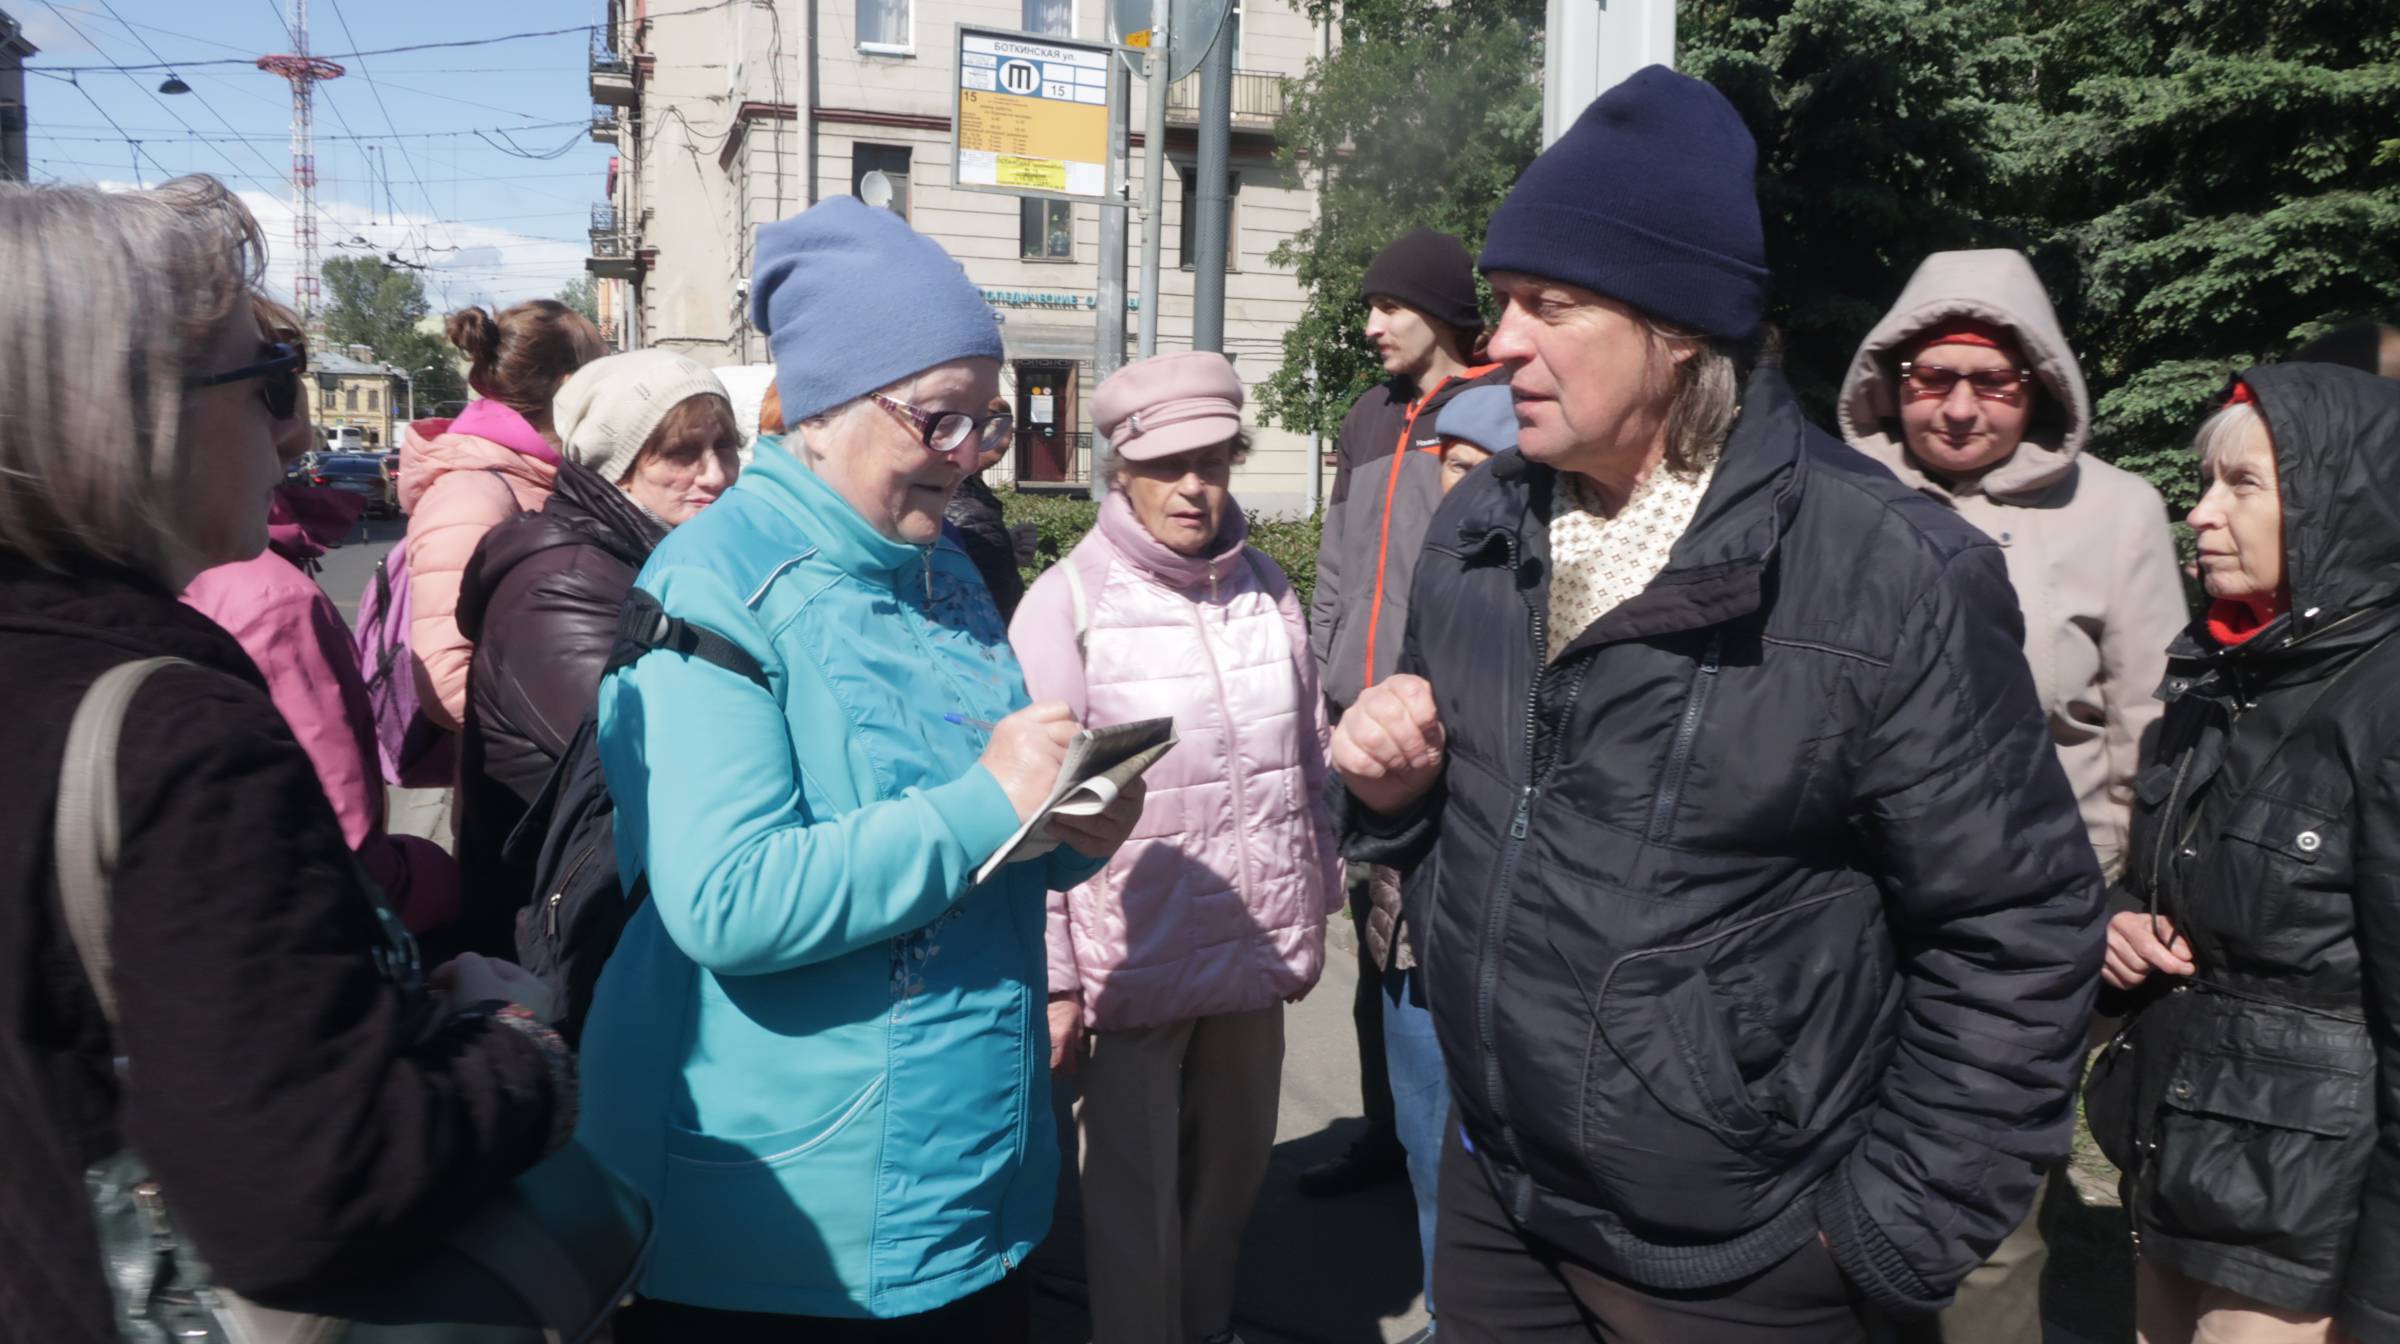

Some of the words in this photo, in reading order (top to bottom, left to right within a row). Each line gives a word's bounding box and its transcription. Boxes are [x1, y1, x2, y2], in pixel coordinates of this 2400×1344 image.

[994, 42, 1060, 58] БОТКИНСКАЯ
[963, 91, 977, 102] 15
[1052, 85, 1065, 97] 15
